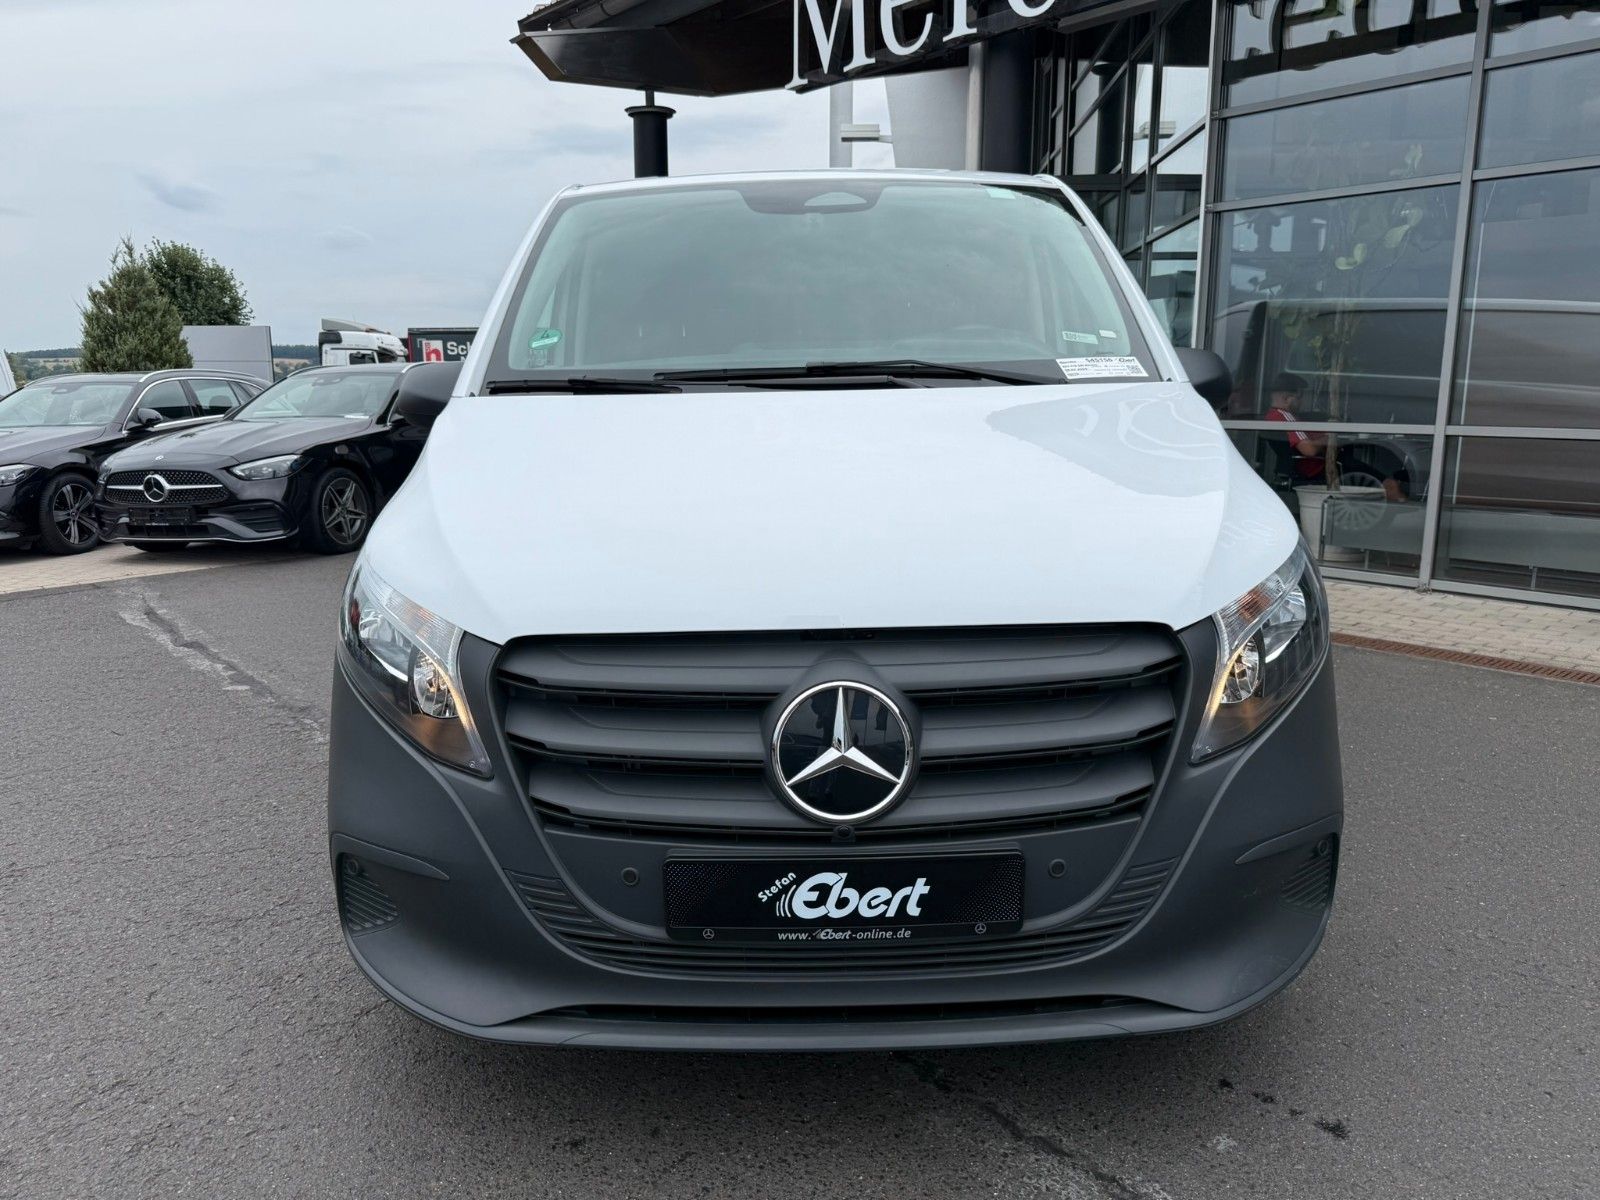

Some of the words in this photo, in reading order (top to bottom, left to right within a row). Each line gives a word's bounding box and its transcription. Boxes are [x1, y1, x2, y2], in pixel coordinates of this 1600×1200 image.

[757, 871, 797, 903] Stefan
[791, 871, 931, 920] Ebert
[777, 928, 912, 941] www.Ebert-online.de
